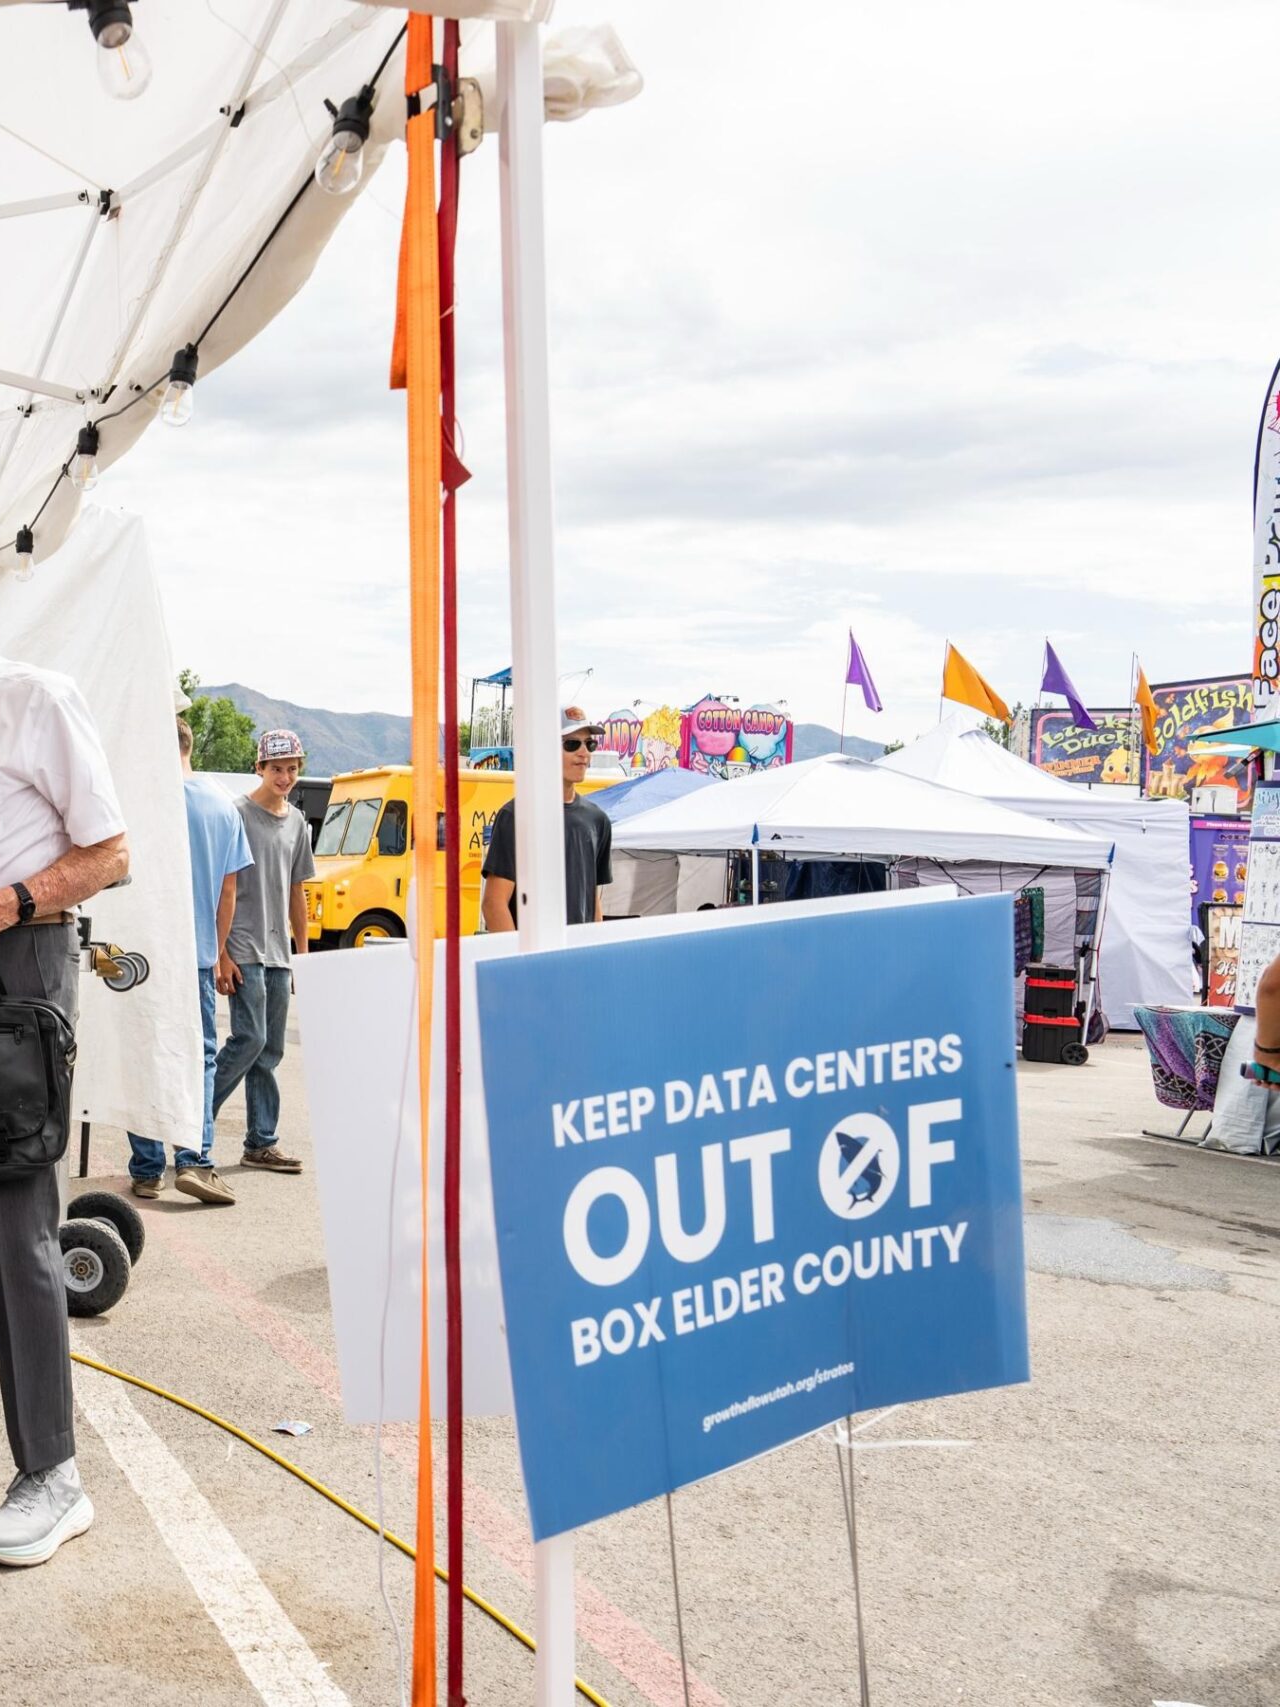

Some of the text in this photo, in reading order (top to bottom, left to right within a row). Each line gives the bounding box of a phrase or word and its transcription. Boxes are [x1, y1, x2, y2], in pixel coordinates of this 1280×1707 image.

[697, 709, 786, 736] COTTON CANDY
[1153, 684, 1253, 757] Goldfish
[552, 1034, 963, 1148] KEEP DATA CENTERS
[563, 1097, 963, 1287] OUT OF
[571, 1222, 969, 1367] BOX ELDER COUNTY
[702, 1361, 855, 1433] growtheflowutah.org/stratos
